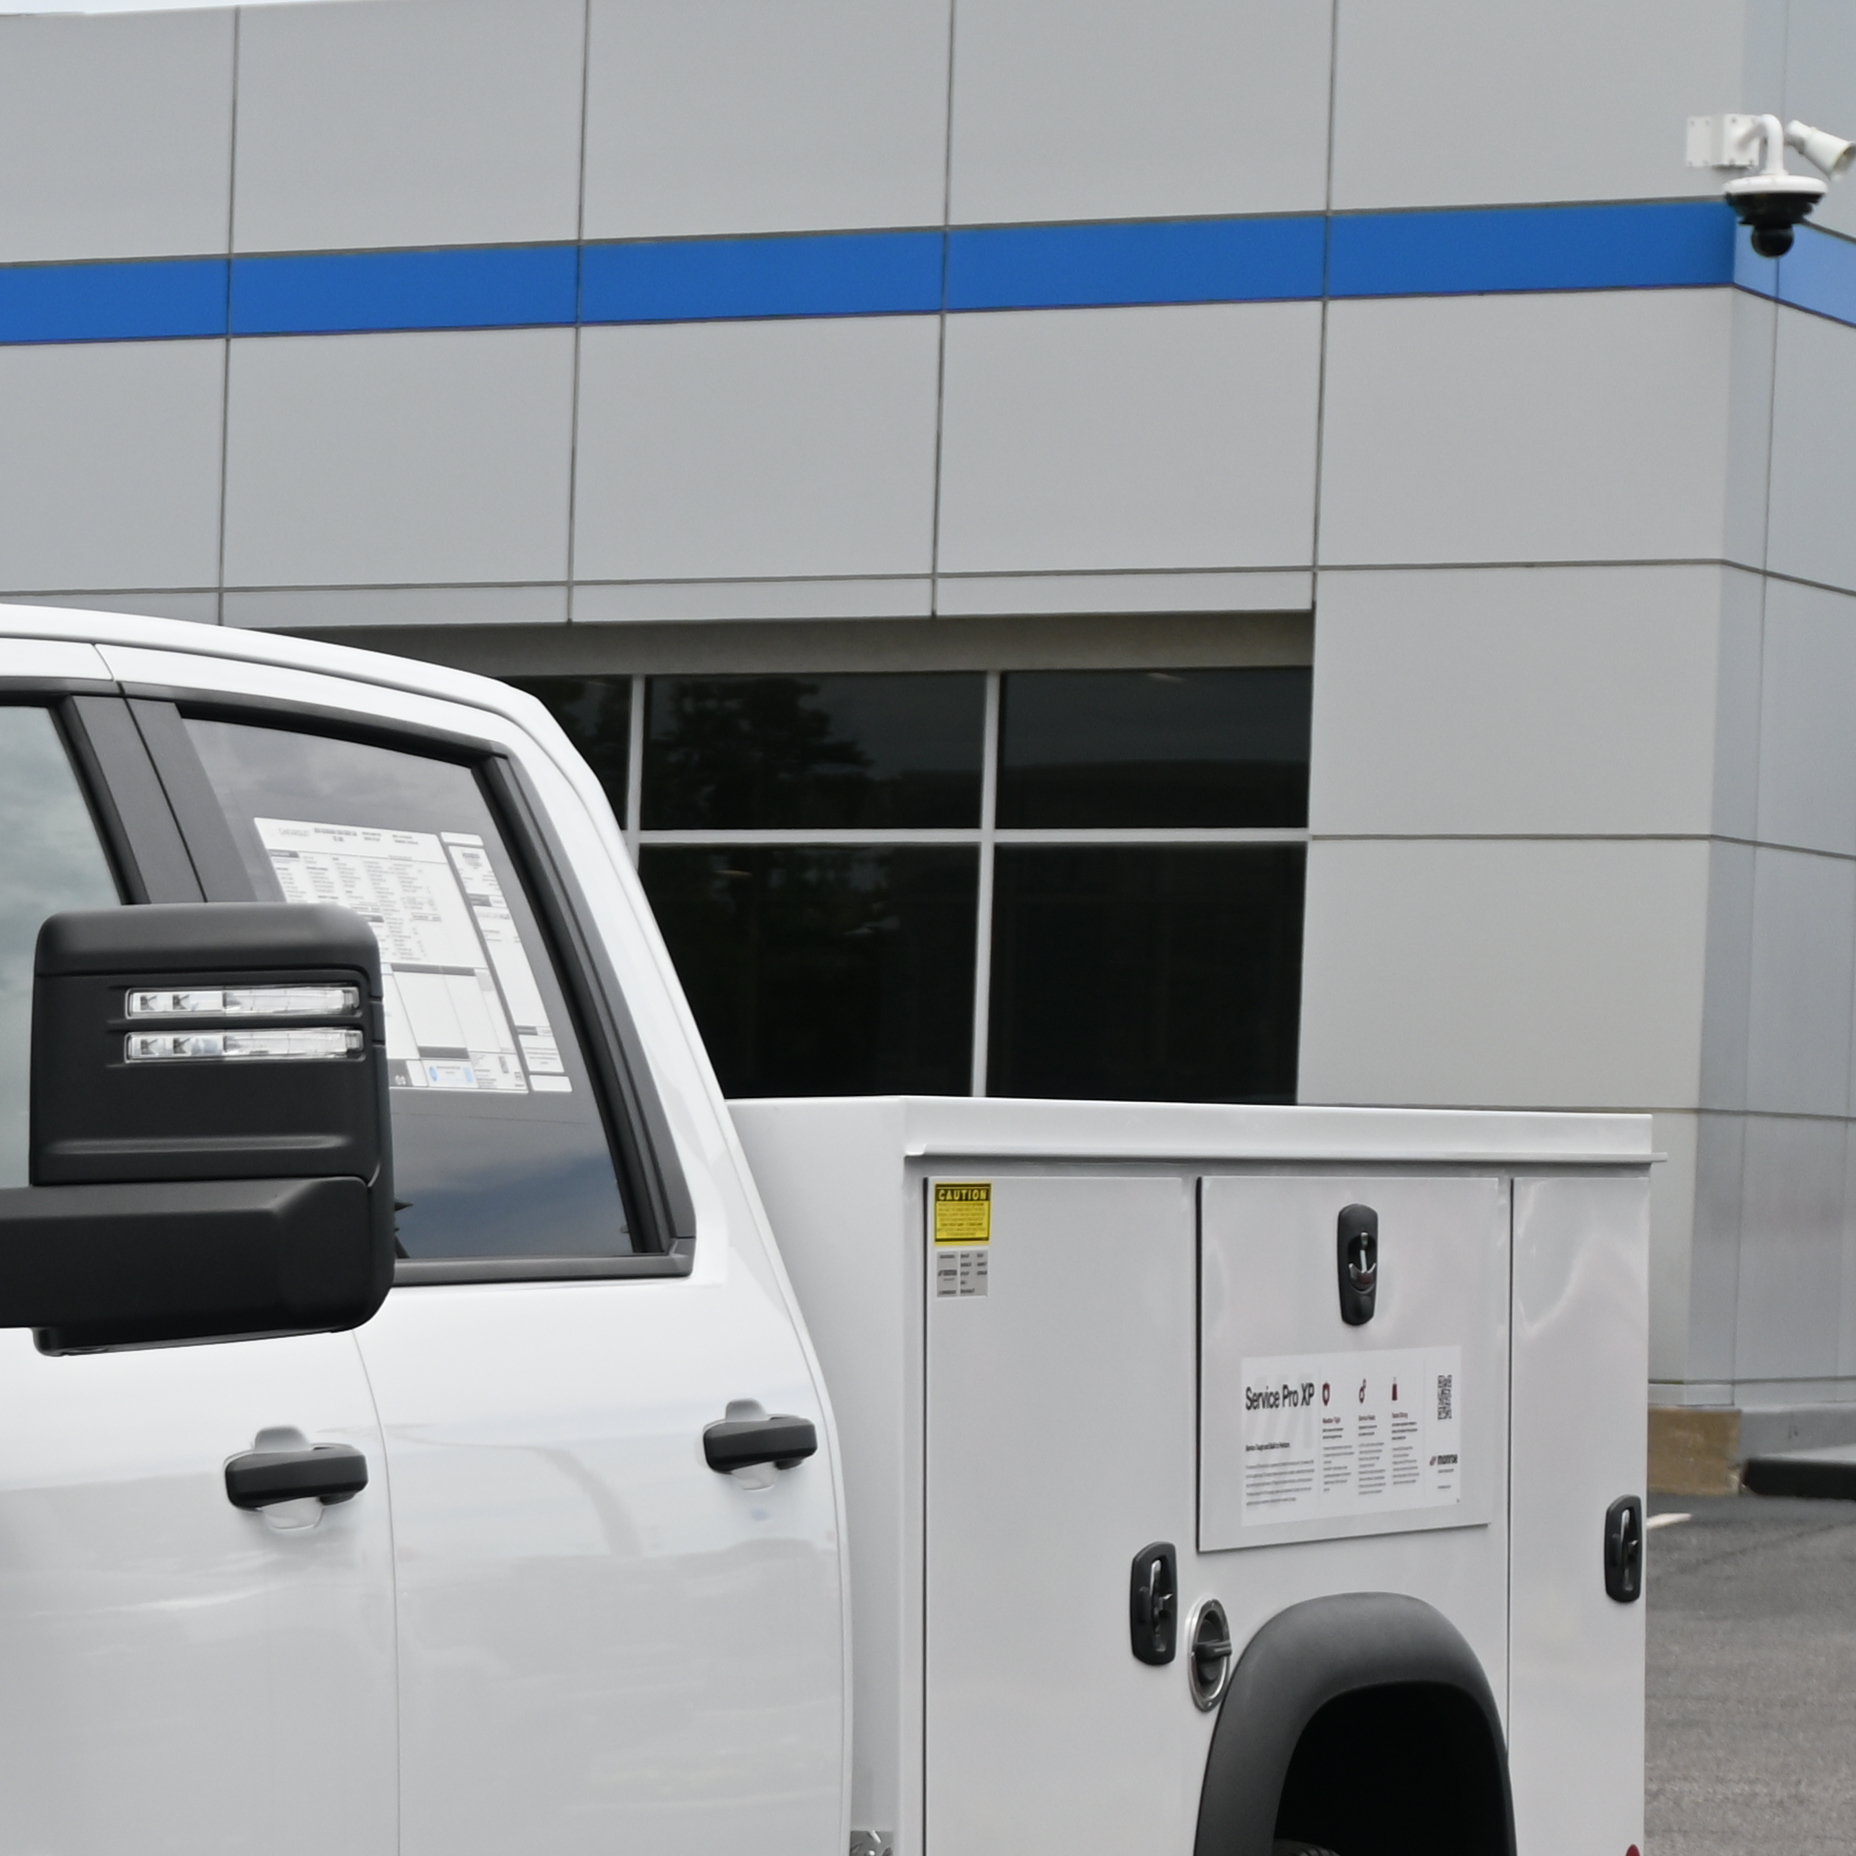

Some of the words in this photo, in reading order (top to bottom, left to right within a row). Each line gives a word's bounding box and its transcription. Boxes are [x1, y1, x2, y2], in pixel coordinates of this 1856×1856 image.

[938, 1189, 987, 1201] CAUTION
[1245, 1385, 1279, 1411] Service
[1282, 1384, 1299, 1408] Pro
[1300, 1382, 1315, 1406] XP
